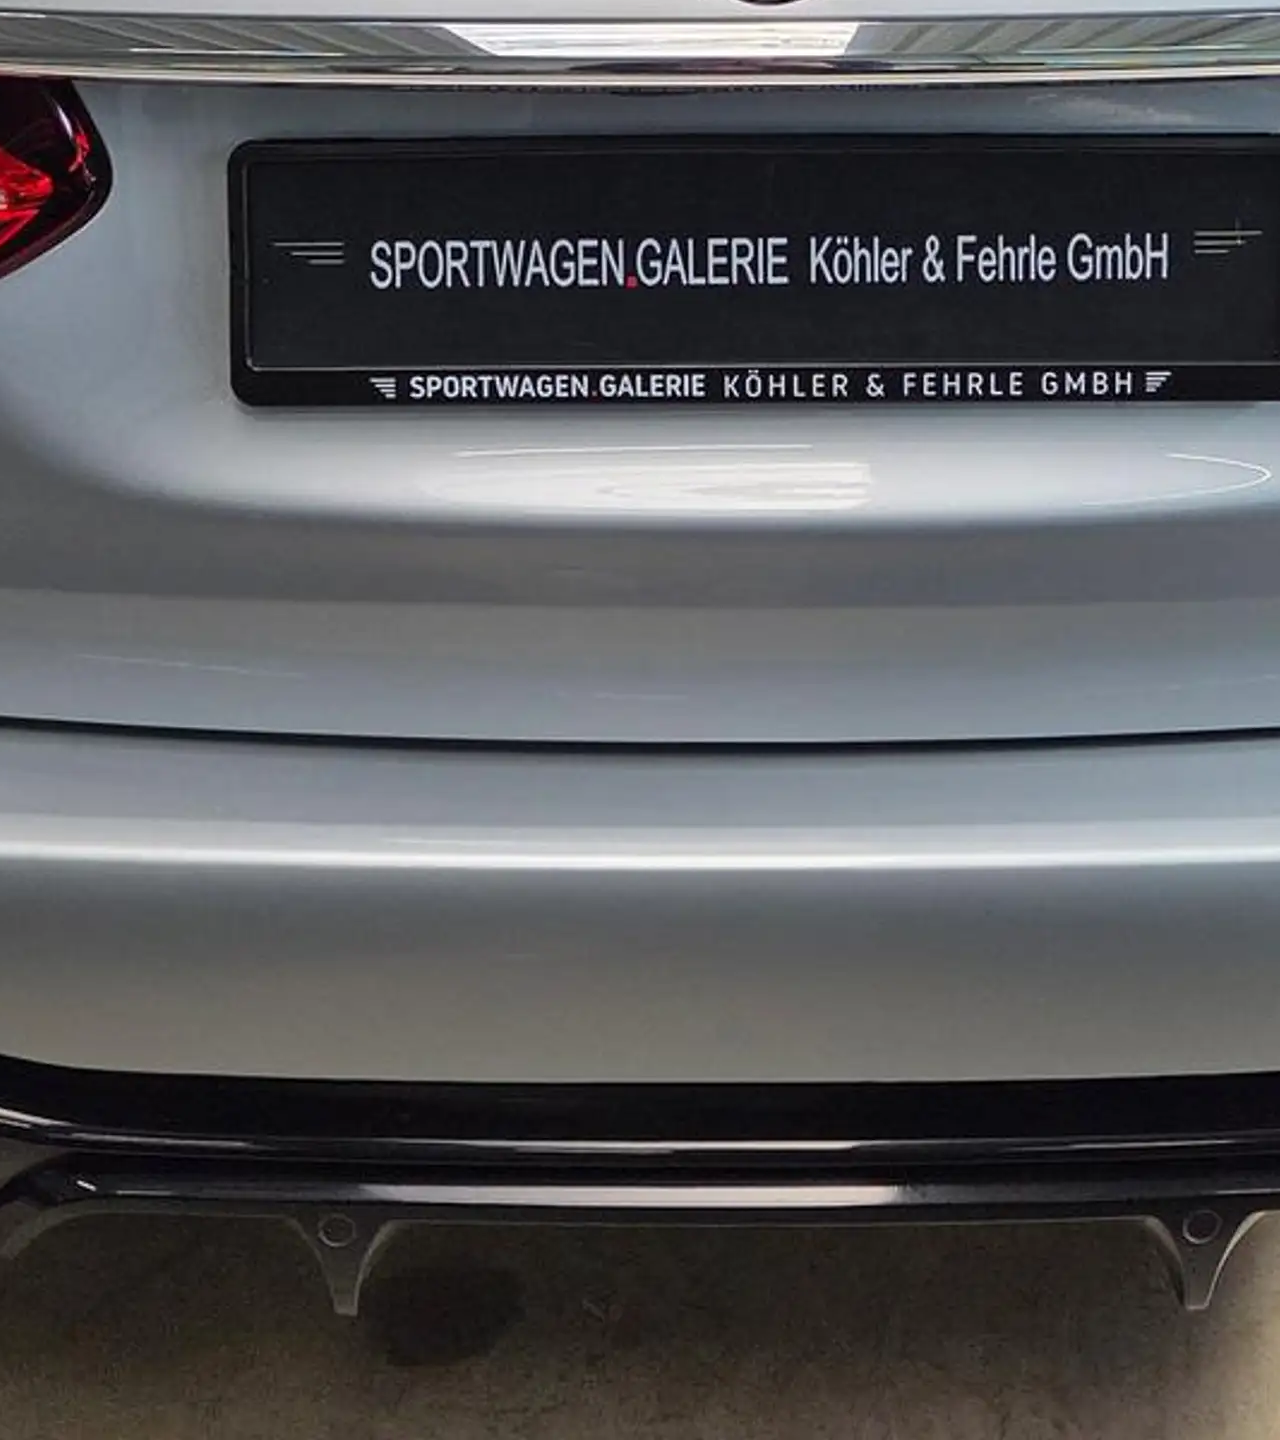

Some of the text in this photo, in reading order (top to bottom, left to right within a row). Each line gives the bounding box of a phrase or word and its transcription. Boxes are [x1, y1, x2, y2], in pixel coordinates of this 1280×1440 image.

[370, 232, 1169, 289] SPORTWAGEN.GALERIE Köhler & Fehrle GmbH
[723, 370, 849, 398] KÖHLER
[865, 373, 885, 397] &
[903, 371, 1024, 396] FEHRLE
[1040, 370, 1133, 395] GMBH
